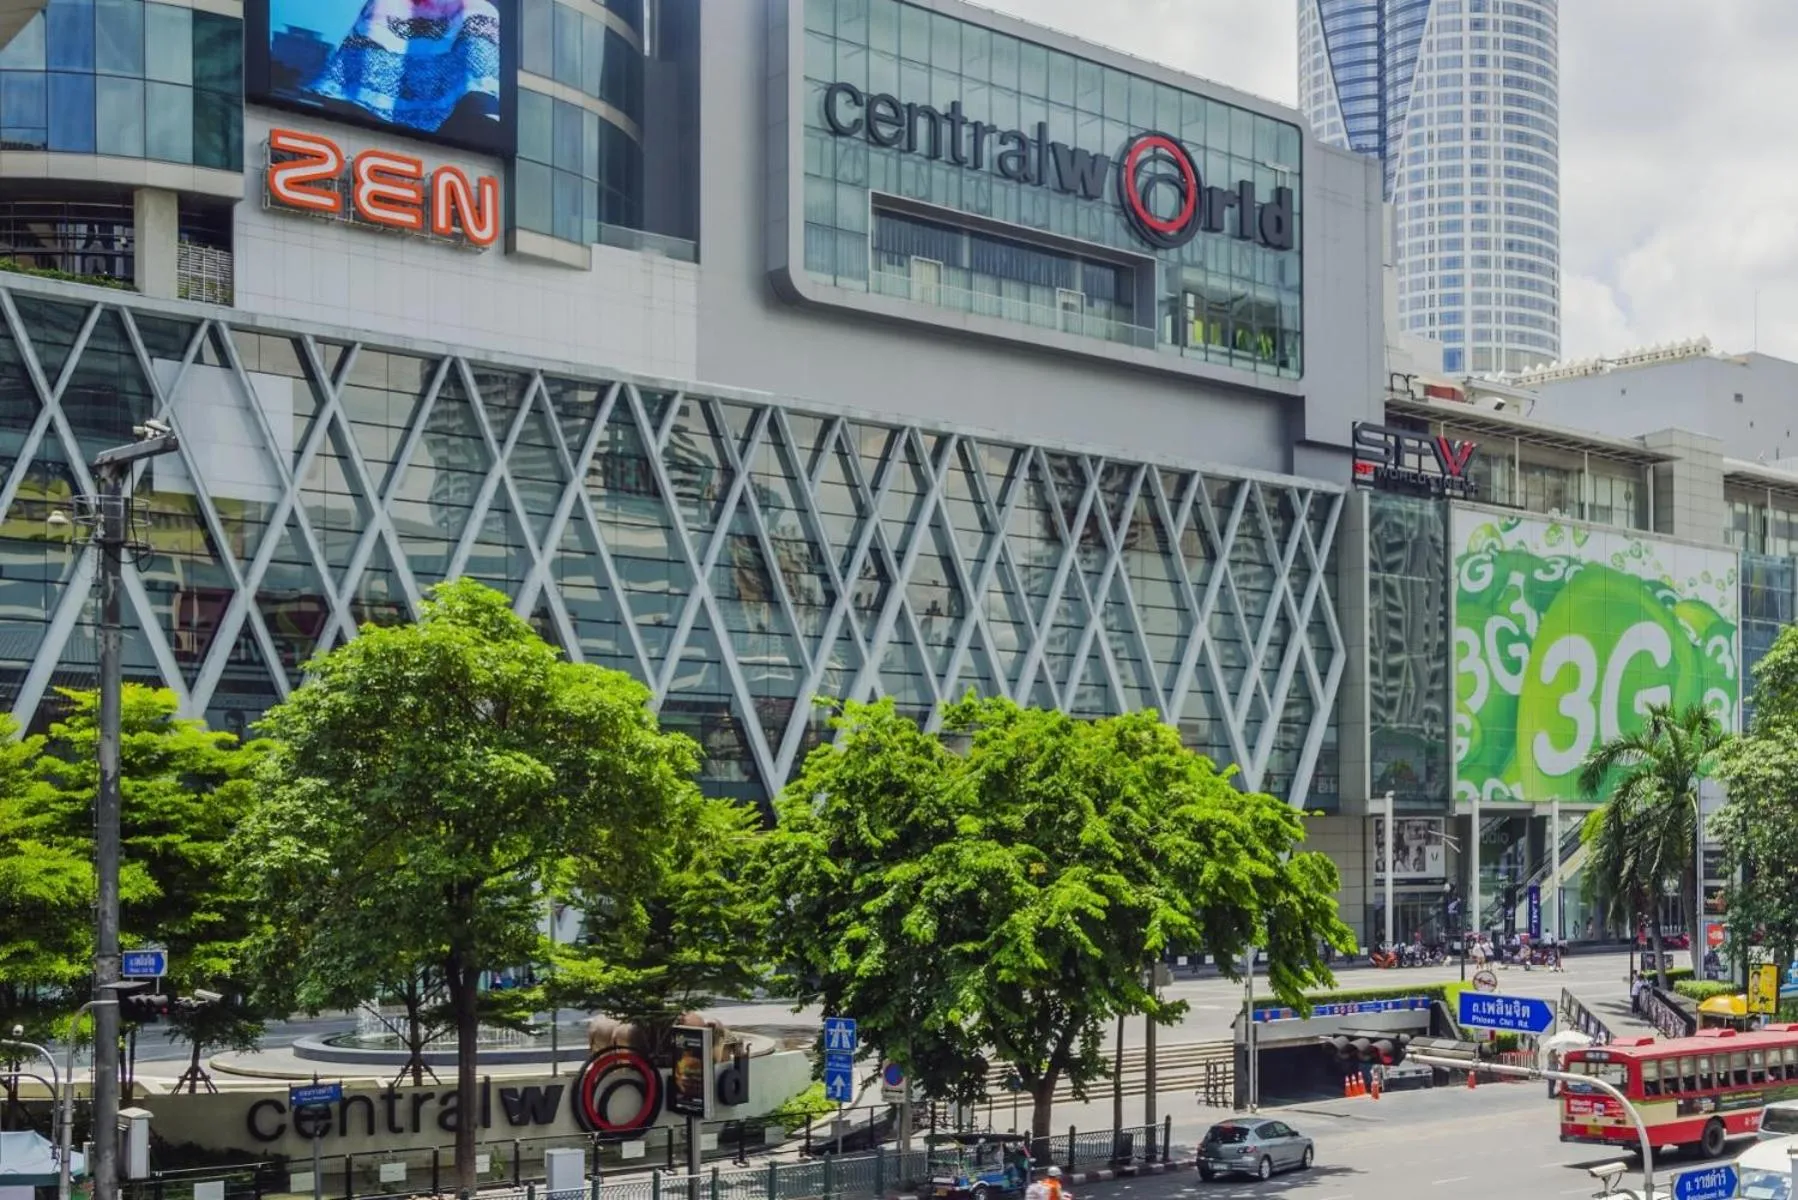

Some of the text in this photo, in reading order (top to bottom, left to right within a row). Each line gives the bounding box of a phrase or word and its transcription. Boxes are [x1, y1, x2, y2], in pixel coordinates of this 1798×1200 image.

[267, 128, 500, 247] ZEN
[1378, 466, 1426, 485] WORLD
[1532, 621, 1672, 776] 3G
